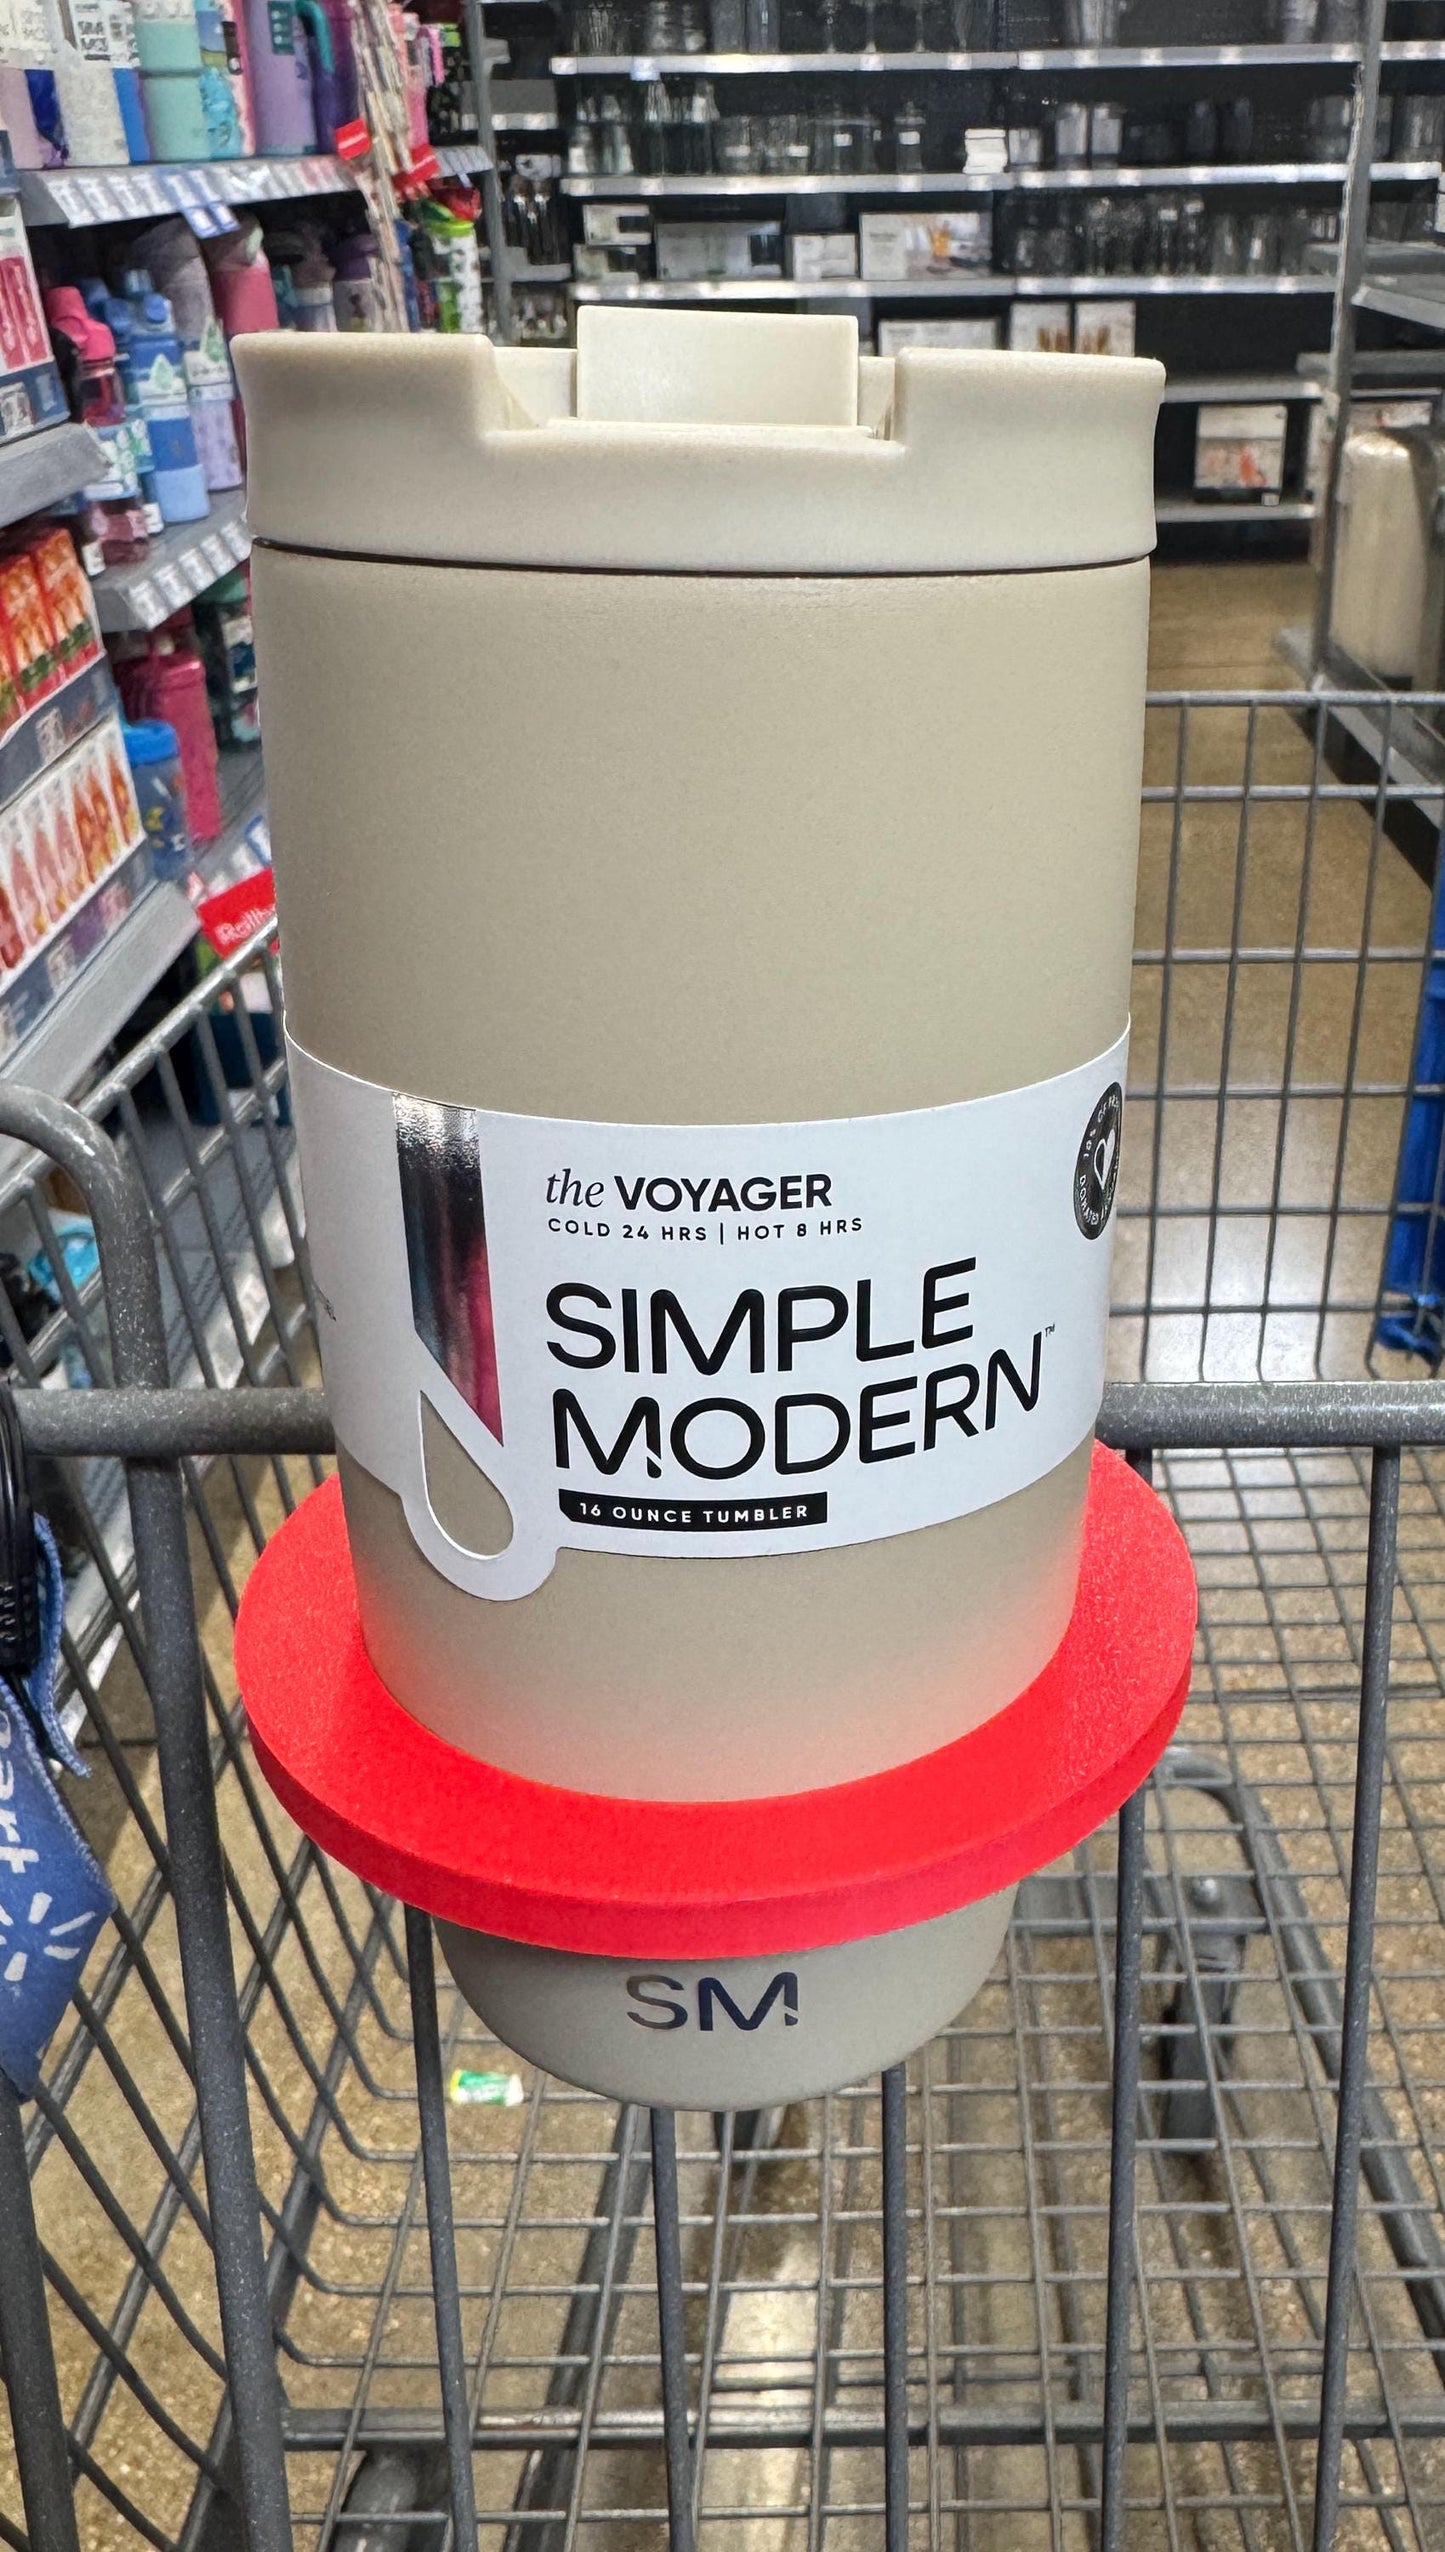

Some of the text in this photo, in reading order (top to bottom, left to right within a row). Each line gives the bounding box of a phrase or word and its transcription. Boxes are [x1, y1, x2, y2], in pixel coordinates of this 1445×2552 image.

[546, 1168, 832, 1213] the VOYAGER
[547, 1217, 611, 1237] COLD
[622, 1223, 650, 1240] 24
[661, 1225, 707, 1241] HRS
[737, 1224, 786, 1241] HOT
[796, 1222, 807, 1238] 8
[819, 1217, 862, 1236] HRS
[546, 1256, 977, 1376] SIMPLE
[579, 1502, 809, 1524] 16 OUNCE TUMBLER
[626, 1971, 799, 2031] SM
